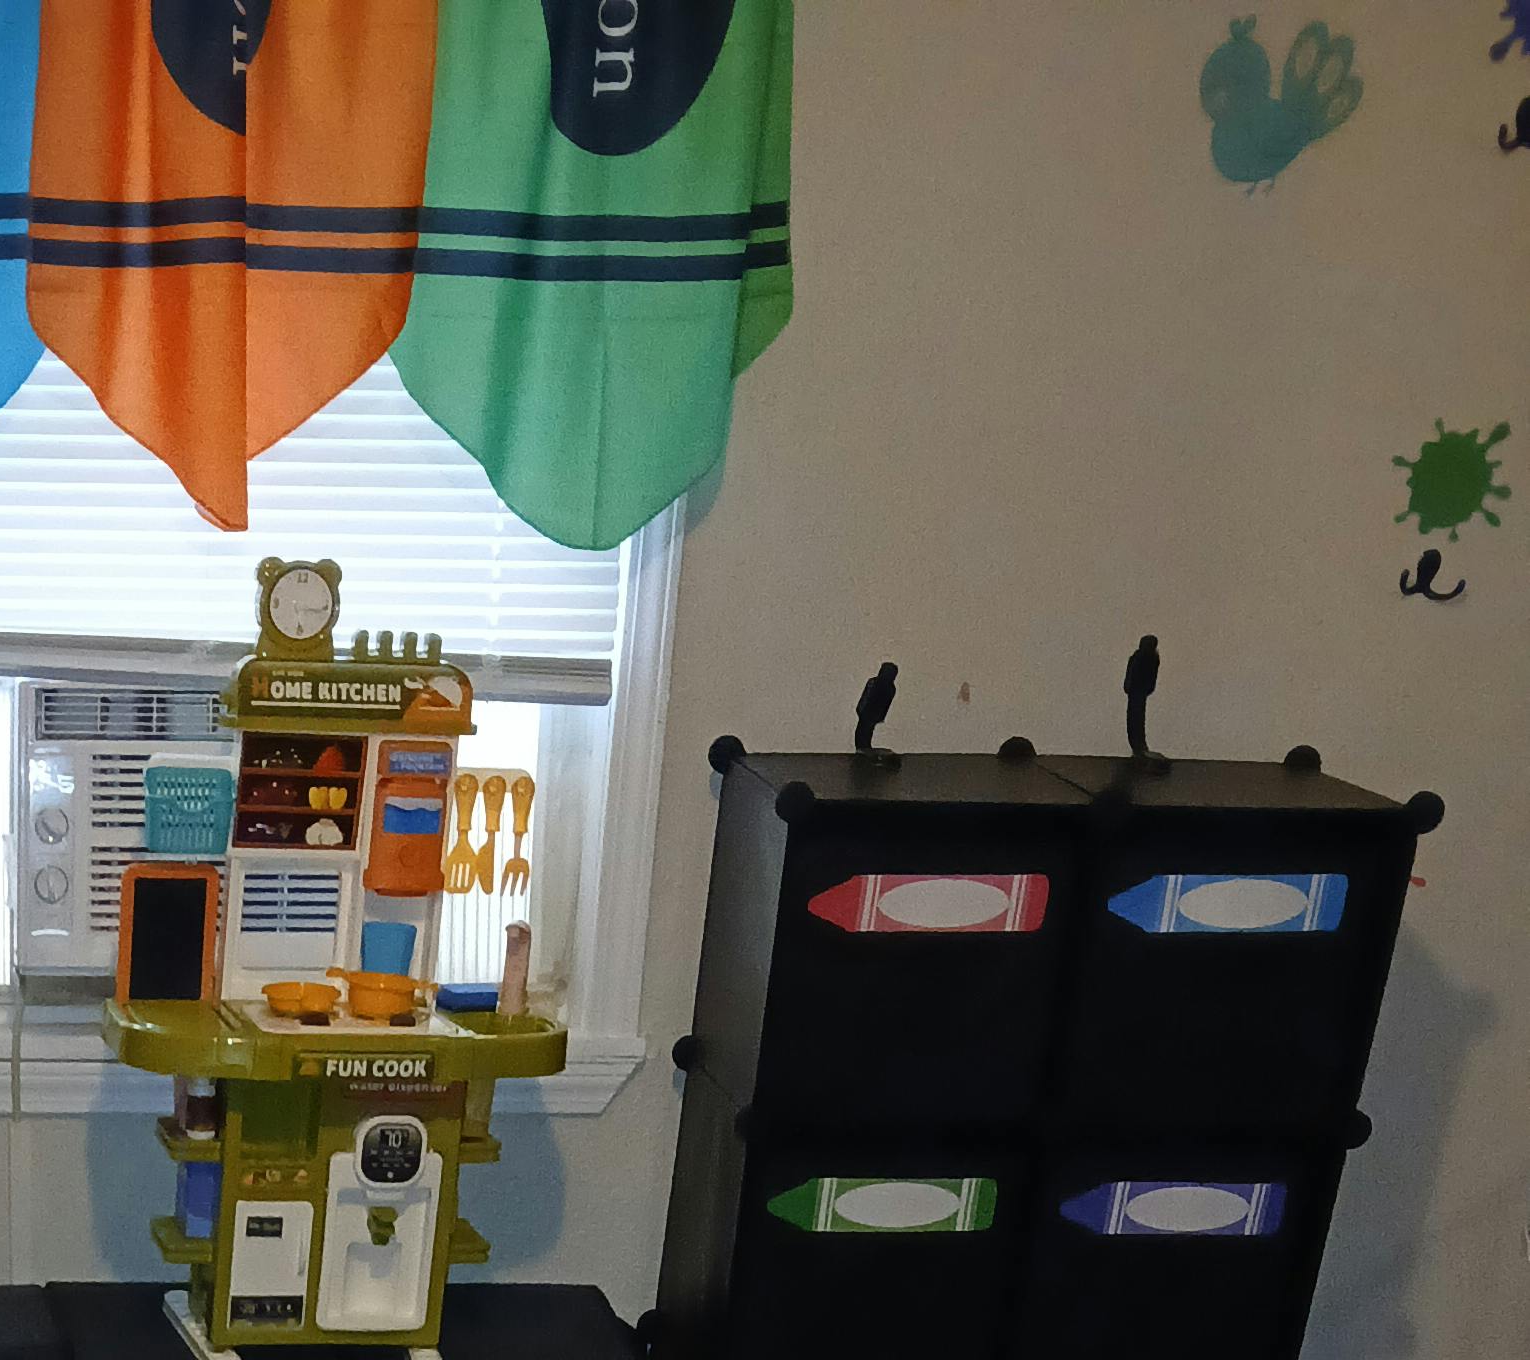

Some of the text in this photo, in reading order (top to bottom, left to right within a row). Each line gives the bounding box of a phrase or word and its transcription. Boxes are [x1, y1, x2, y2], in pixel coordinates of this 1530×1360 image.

[252, 674, 402, 703] HOME KITCHEN
[326, 1059, 427, 1078] FUN COOK
